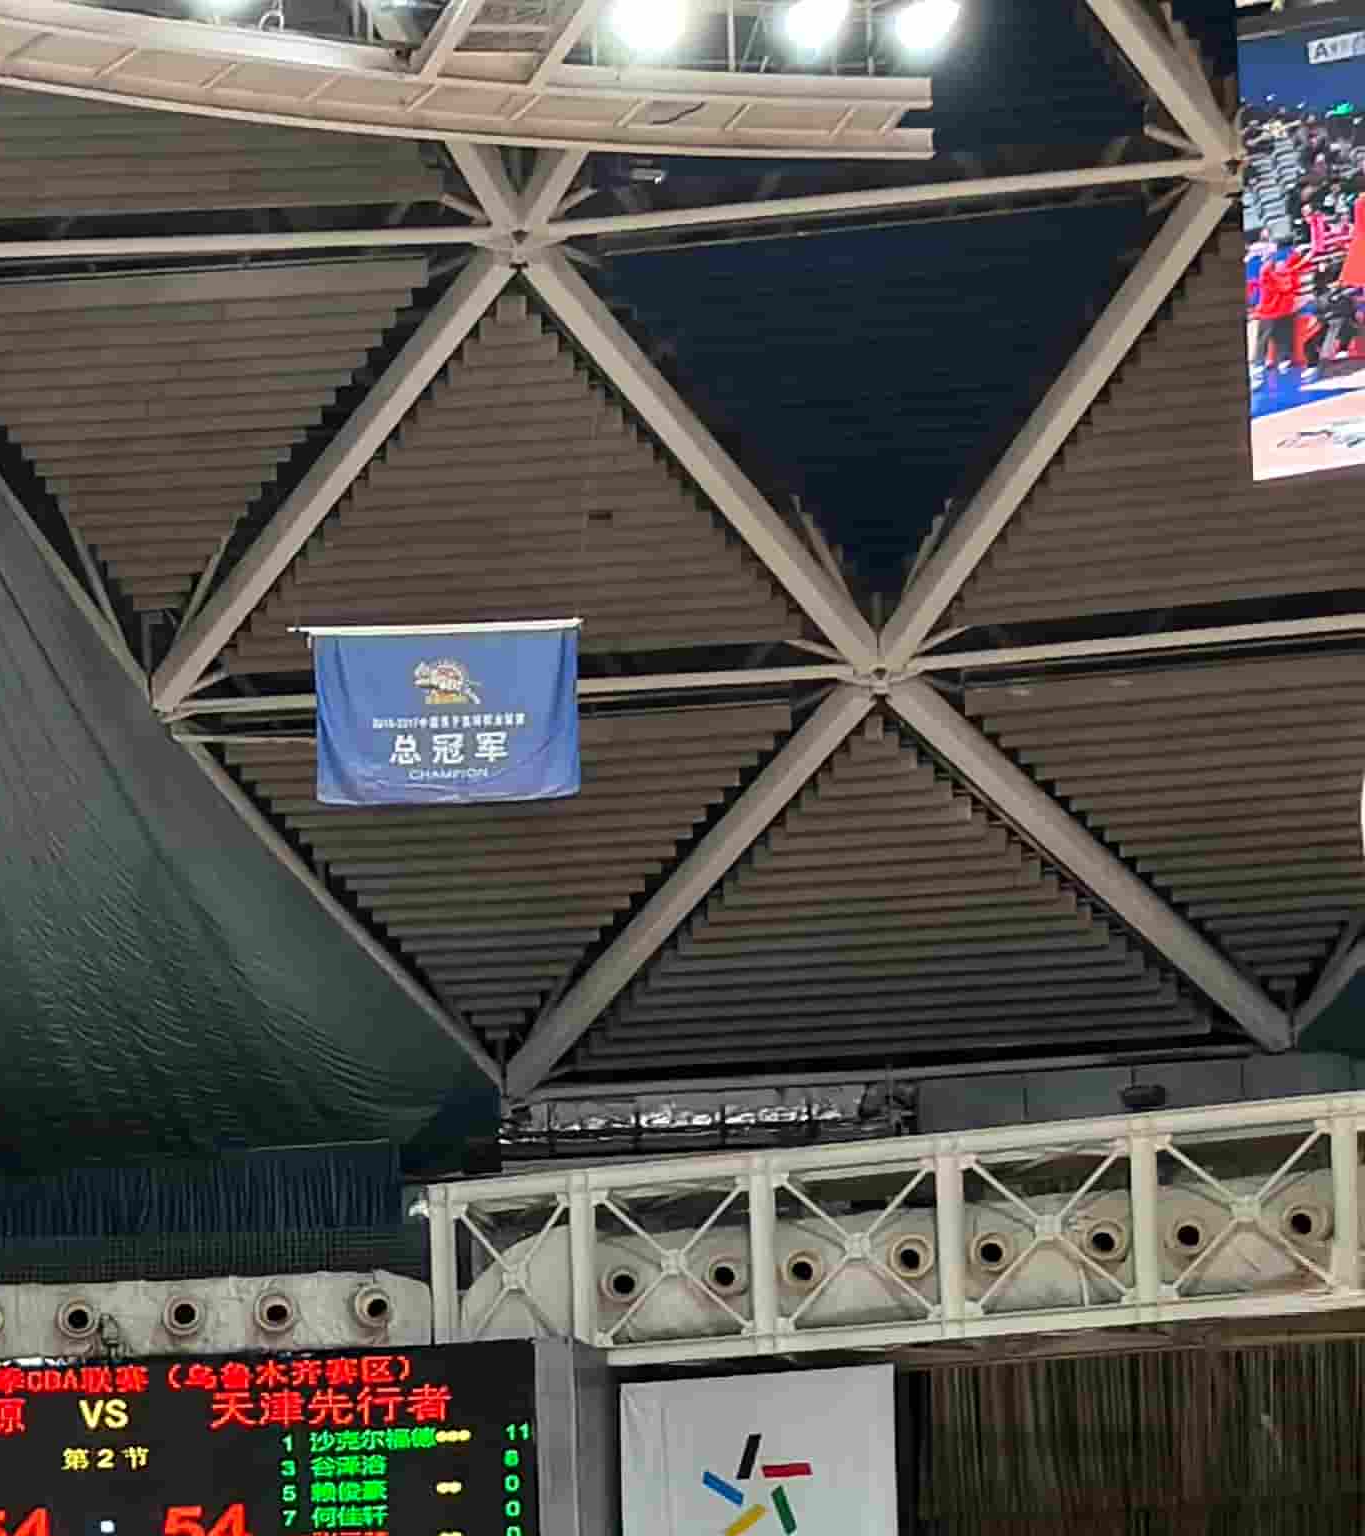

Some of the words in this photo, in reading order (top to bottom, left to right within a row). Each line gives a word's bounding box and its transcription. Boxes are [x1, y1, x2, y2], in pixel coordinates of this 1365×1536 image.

[388, 730, 511, 766] 总冠军
[408, 766, 491, 781] CHAMPION
[78, 1398, 129, 1429] VS
[209, 1385, 453, 1428] 天津先行者
[281, 1433, 293, 1452] 1
[505, 1423, 533, 1441] 11
[280, 1459, 297, 1477] 3
[504, 1474, 520, 1492] 0
[281, 1509, 297, 1527] 7
[505, 1499, 521, 1517] 0
